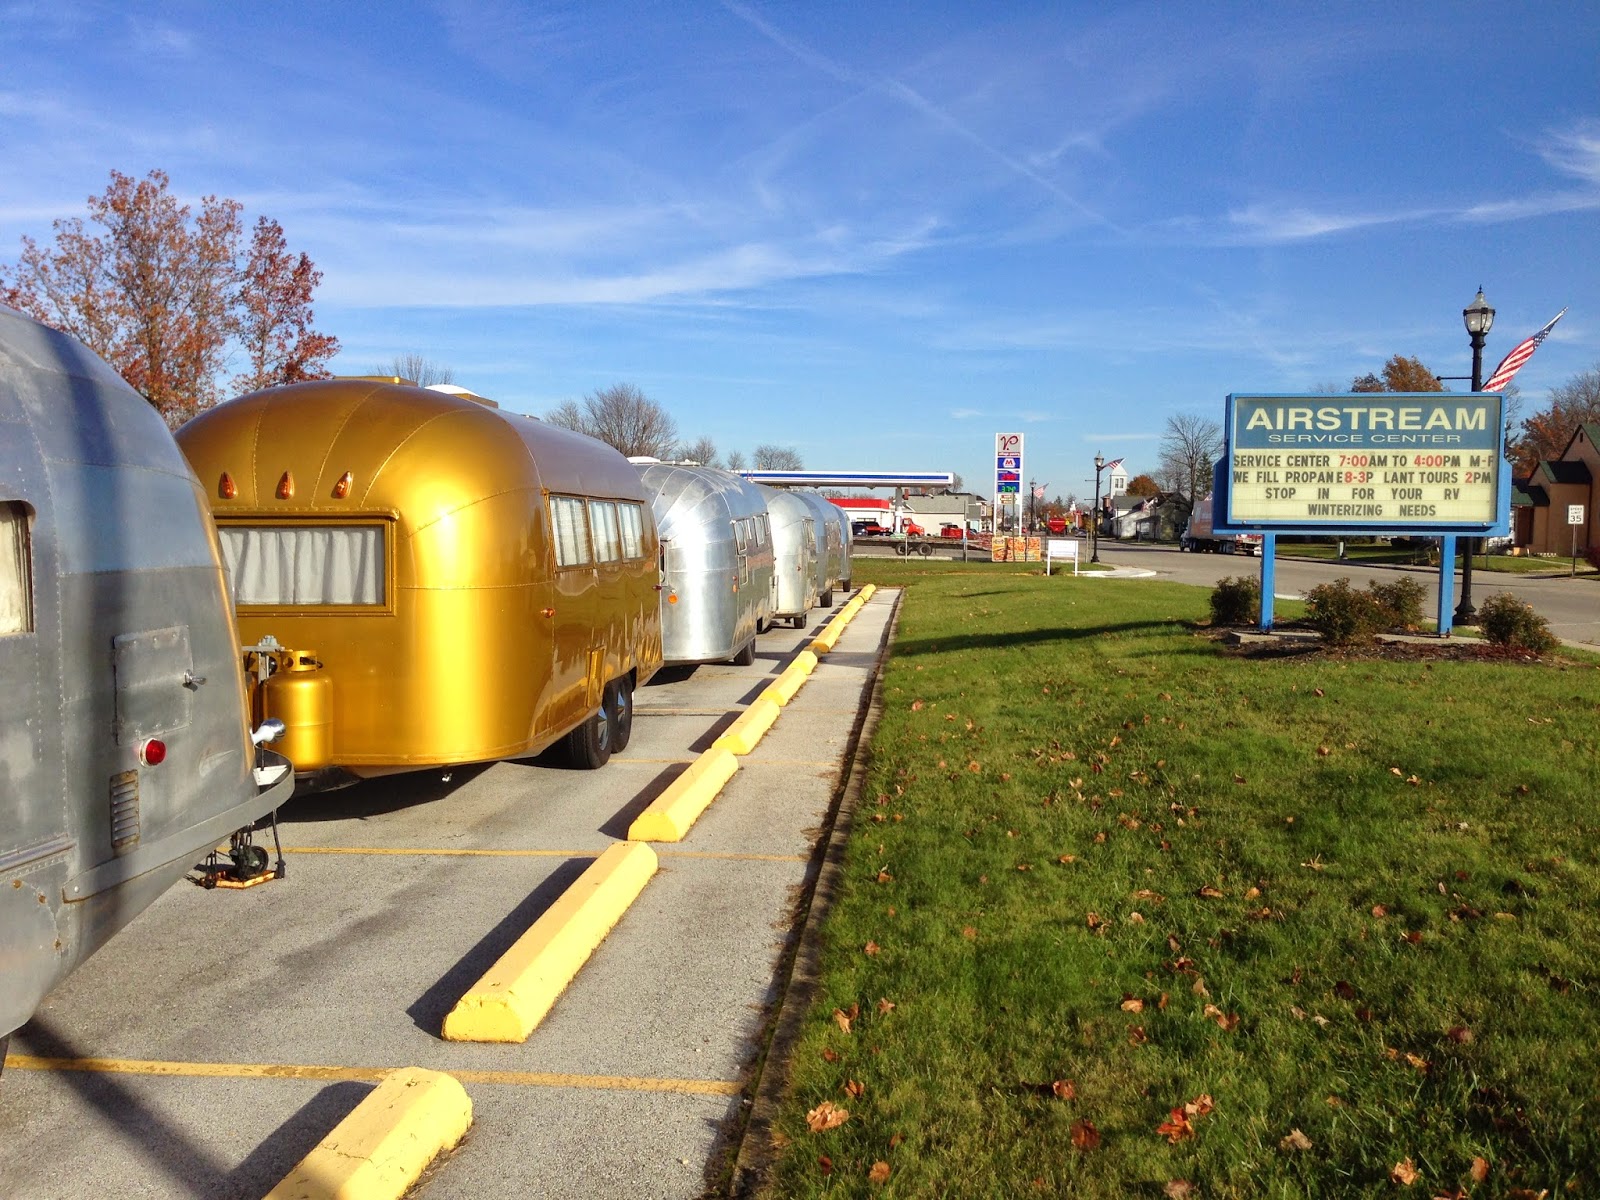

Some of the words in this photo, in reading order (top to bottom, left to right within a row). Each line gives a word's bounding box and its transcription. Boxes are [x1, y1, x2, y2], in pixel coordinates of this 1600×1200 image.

[1246, 407, 1486, 430] AIRSTREAM
[1268, 434, 1363, 442] SERVICE
[1370, 434, 1460, 442] CENTER
[1233, 455, 1281, 467] SERVICE
[1286, 455, 1330, 467] CENTER
[1393, 455, 1407, 467] TO
[1233, 471, 1249, 483] WE
[1256, 471, 1279, 483] FILL
[1384, 472, 1415, 484] LANT
[1419, 472, 1458, 484] TOURS
[1465, 472, 1492, 484] 2PM
[1265, 488, 1296, 499] STOP
[1318, 488, 1330, 500] IN
[1352, 488, 1375, 500] FOR
[1391, 488, 1423, 500] YOUR
[1444, 488, 1460, 500] RV
[1308, 504, 1383, 516] WINTERIZING
[1399, 505, 1436, 517] NEEDS
